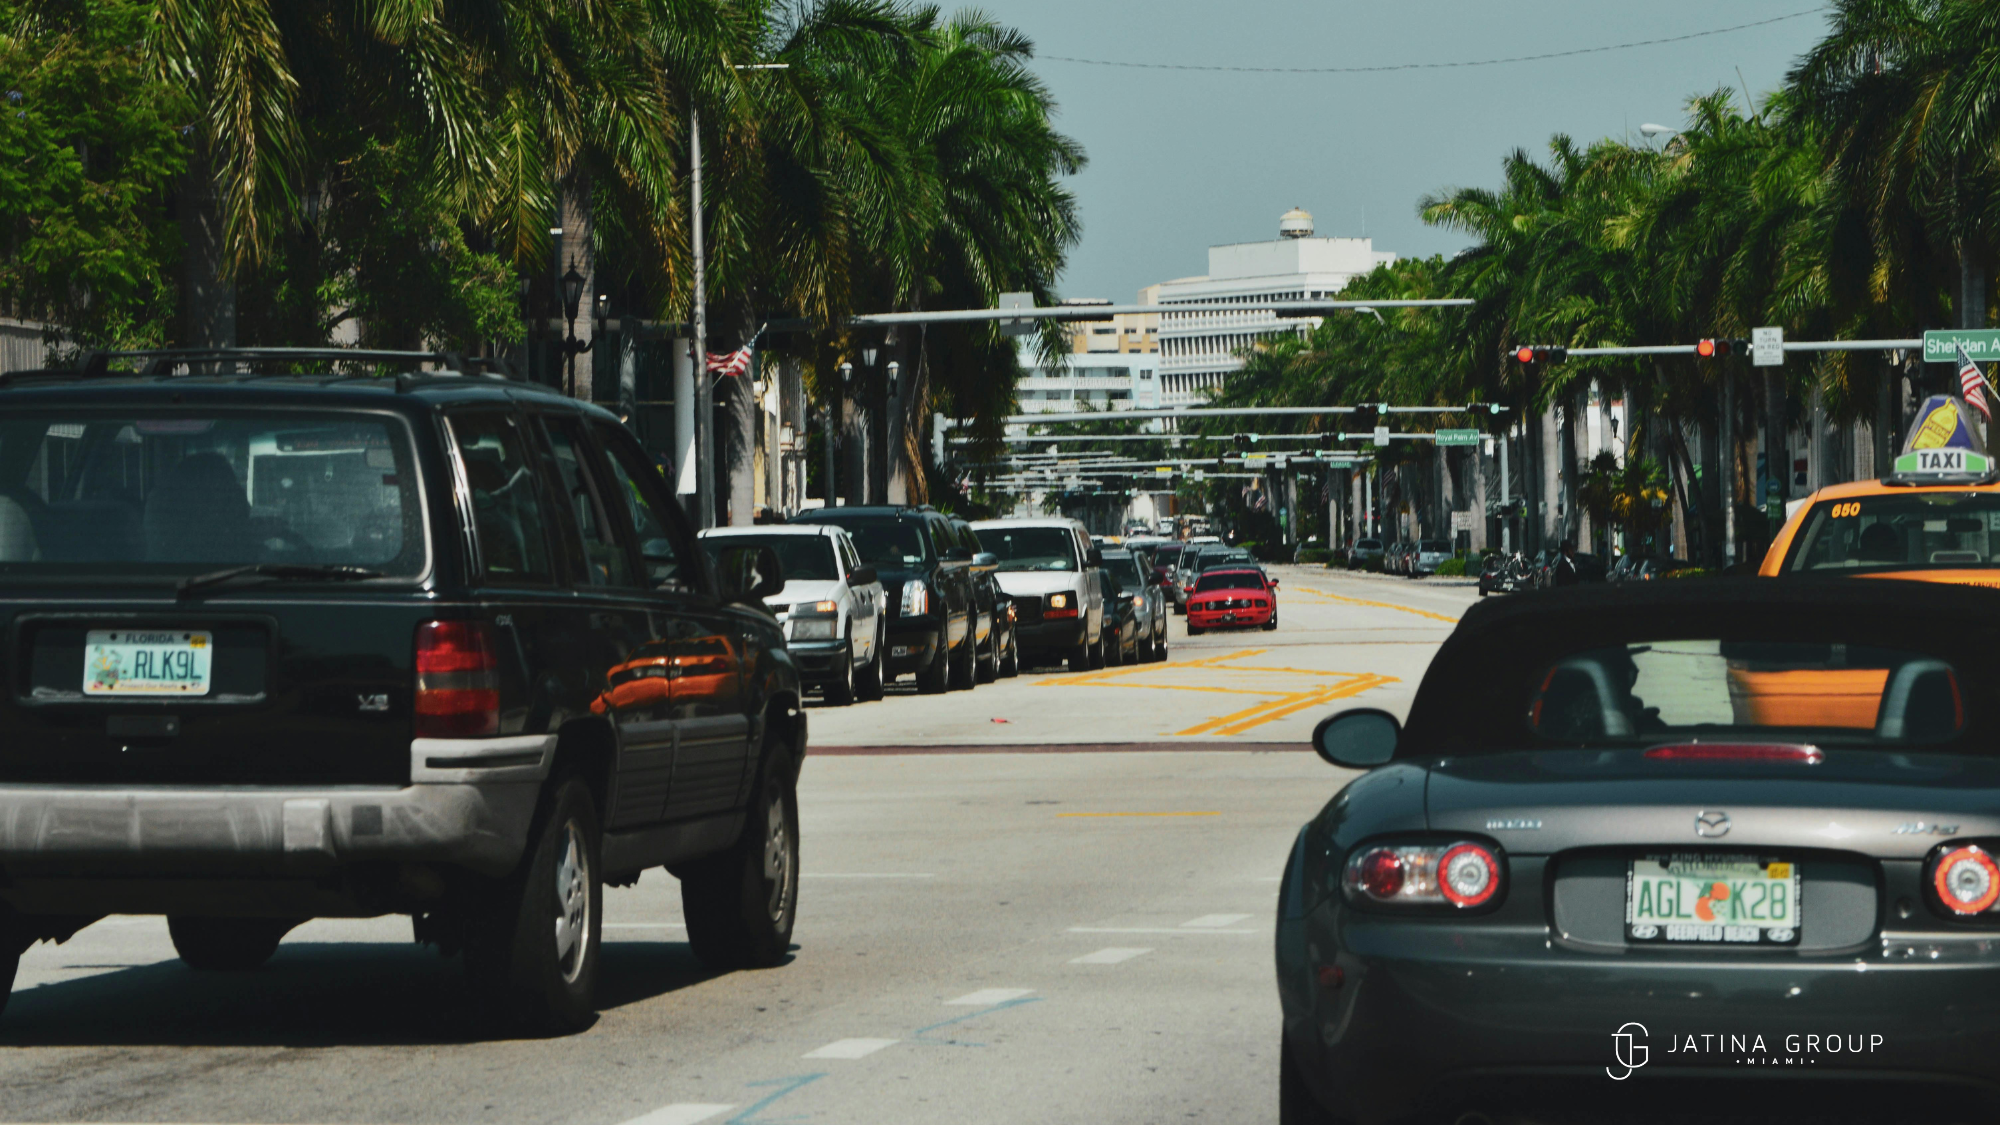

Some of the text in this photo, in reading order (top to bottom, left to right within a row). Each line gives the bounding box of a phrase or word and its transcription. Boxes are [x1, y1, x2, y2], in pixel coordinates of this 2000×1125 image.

[1437, 433, 1478, 442] Royal Palm Av
[1920, 453, 1962, 469] TAXI
[1831, 502, 1861, 518] 650
[125, 633, 175, 644] FLORIDA
[134, 650, 203, 680] RLK9L
[1637, 880, 1692, 918] AGL
[1731, 882, 1787, 920] K28
[1666, 924, 1760, 942] DEERFIELD BEACH
